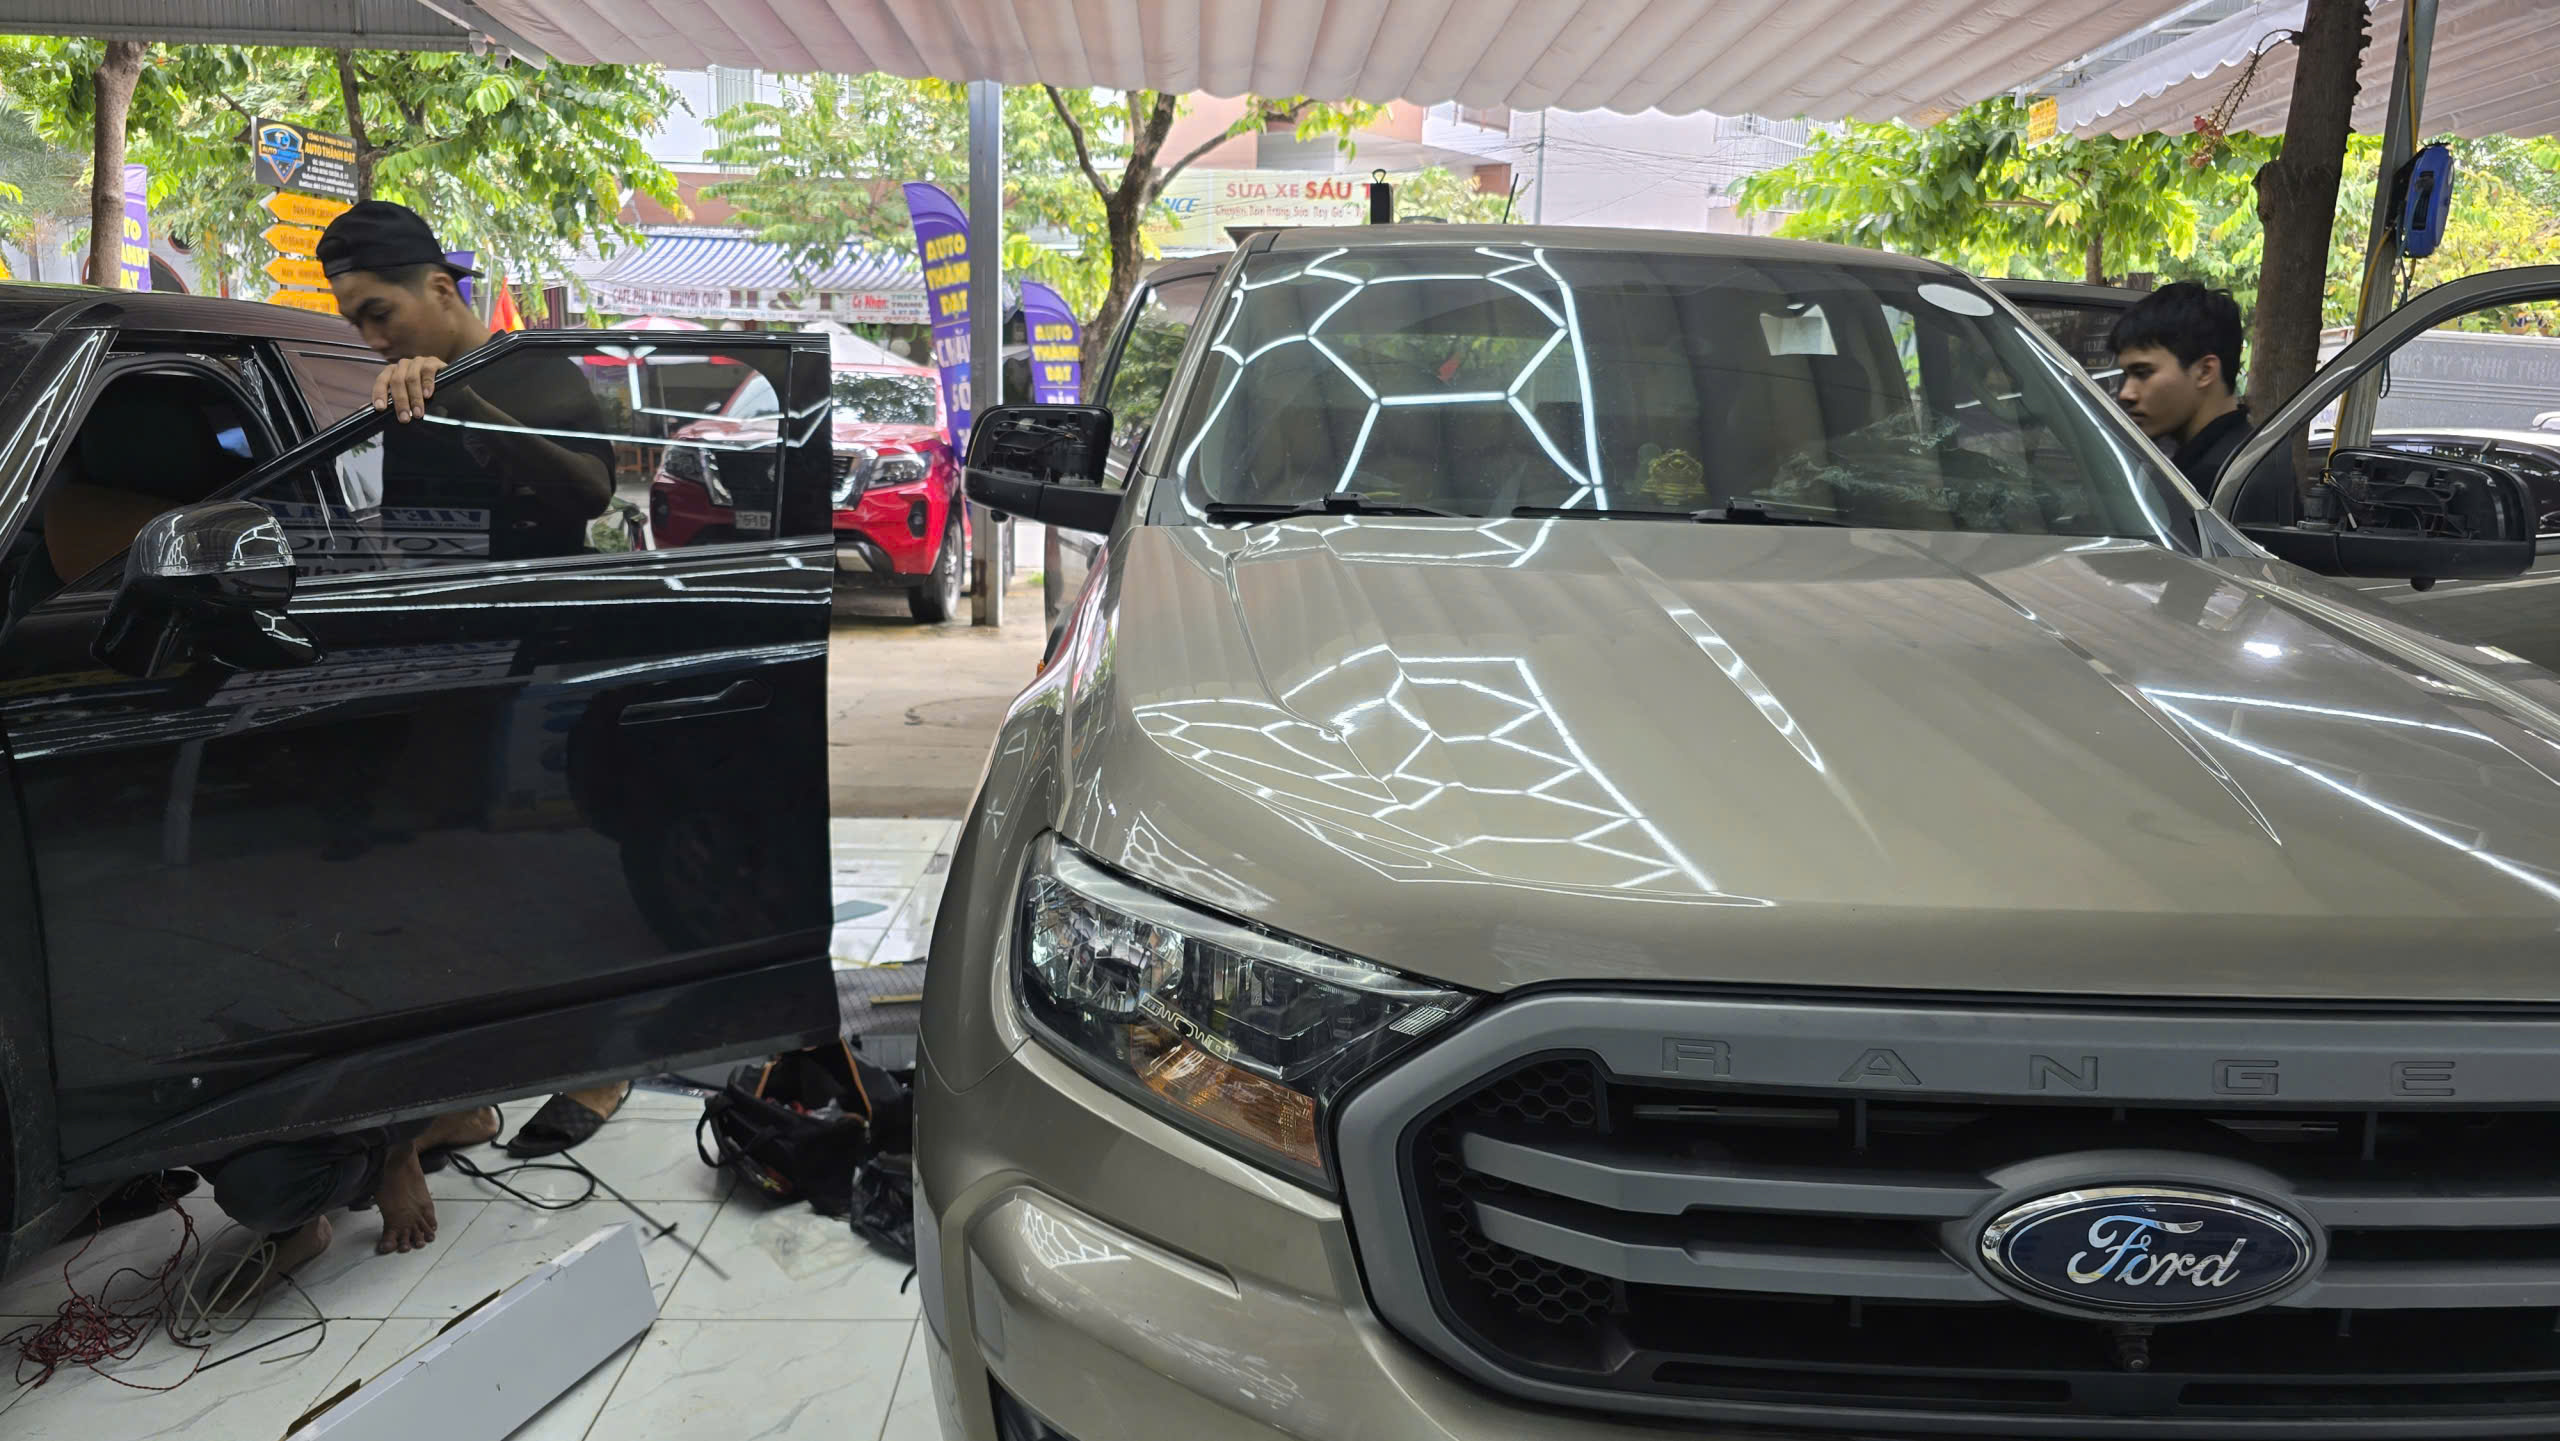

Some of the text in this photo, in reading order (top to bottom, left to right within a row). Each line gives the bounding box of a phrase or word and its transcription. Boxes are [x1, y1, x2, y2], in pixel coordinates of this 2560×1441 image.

[305, 142, 322, 156] AUTO
[1276, 183, 1299, 198] XE
[1306, 178, 1352, 200] SÁU
[1160, 196, 1201, 213] NCE
[925, 233, 967, 263] AUTO
[939, 289, 968, 320] ĐẠT
[1034, 325, 1073, 342] AUTO
[936, 327, 971, 368] CHĂ
[1032, 343, 1080, 363] THÀNH
[1045, 365, 1073, 386] ĐẠT
[2067, 1215, 2247, 1287] Ford
